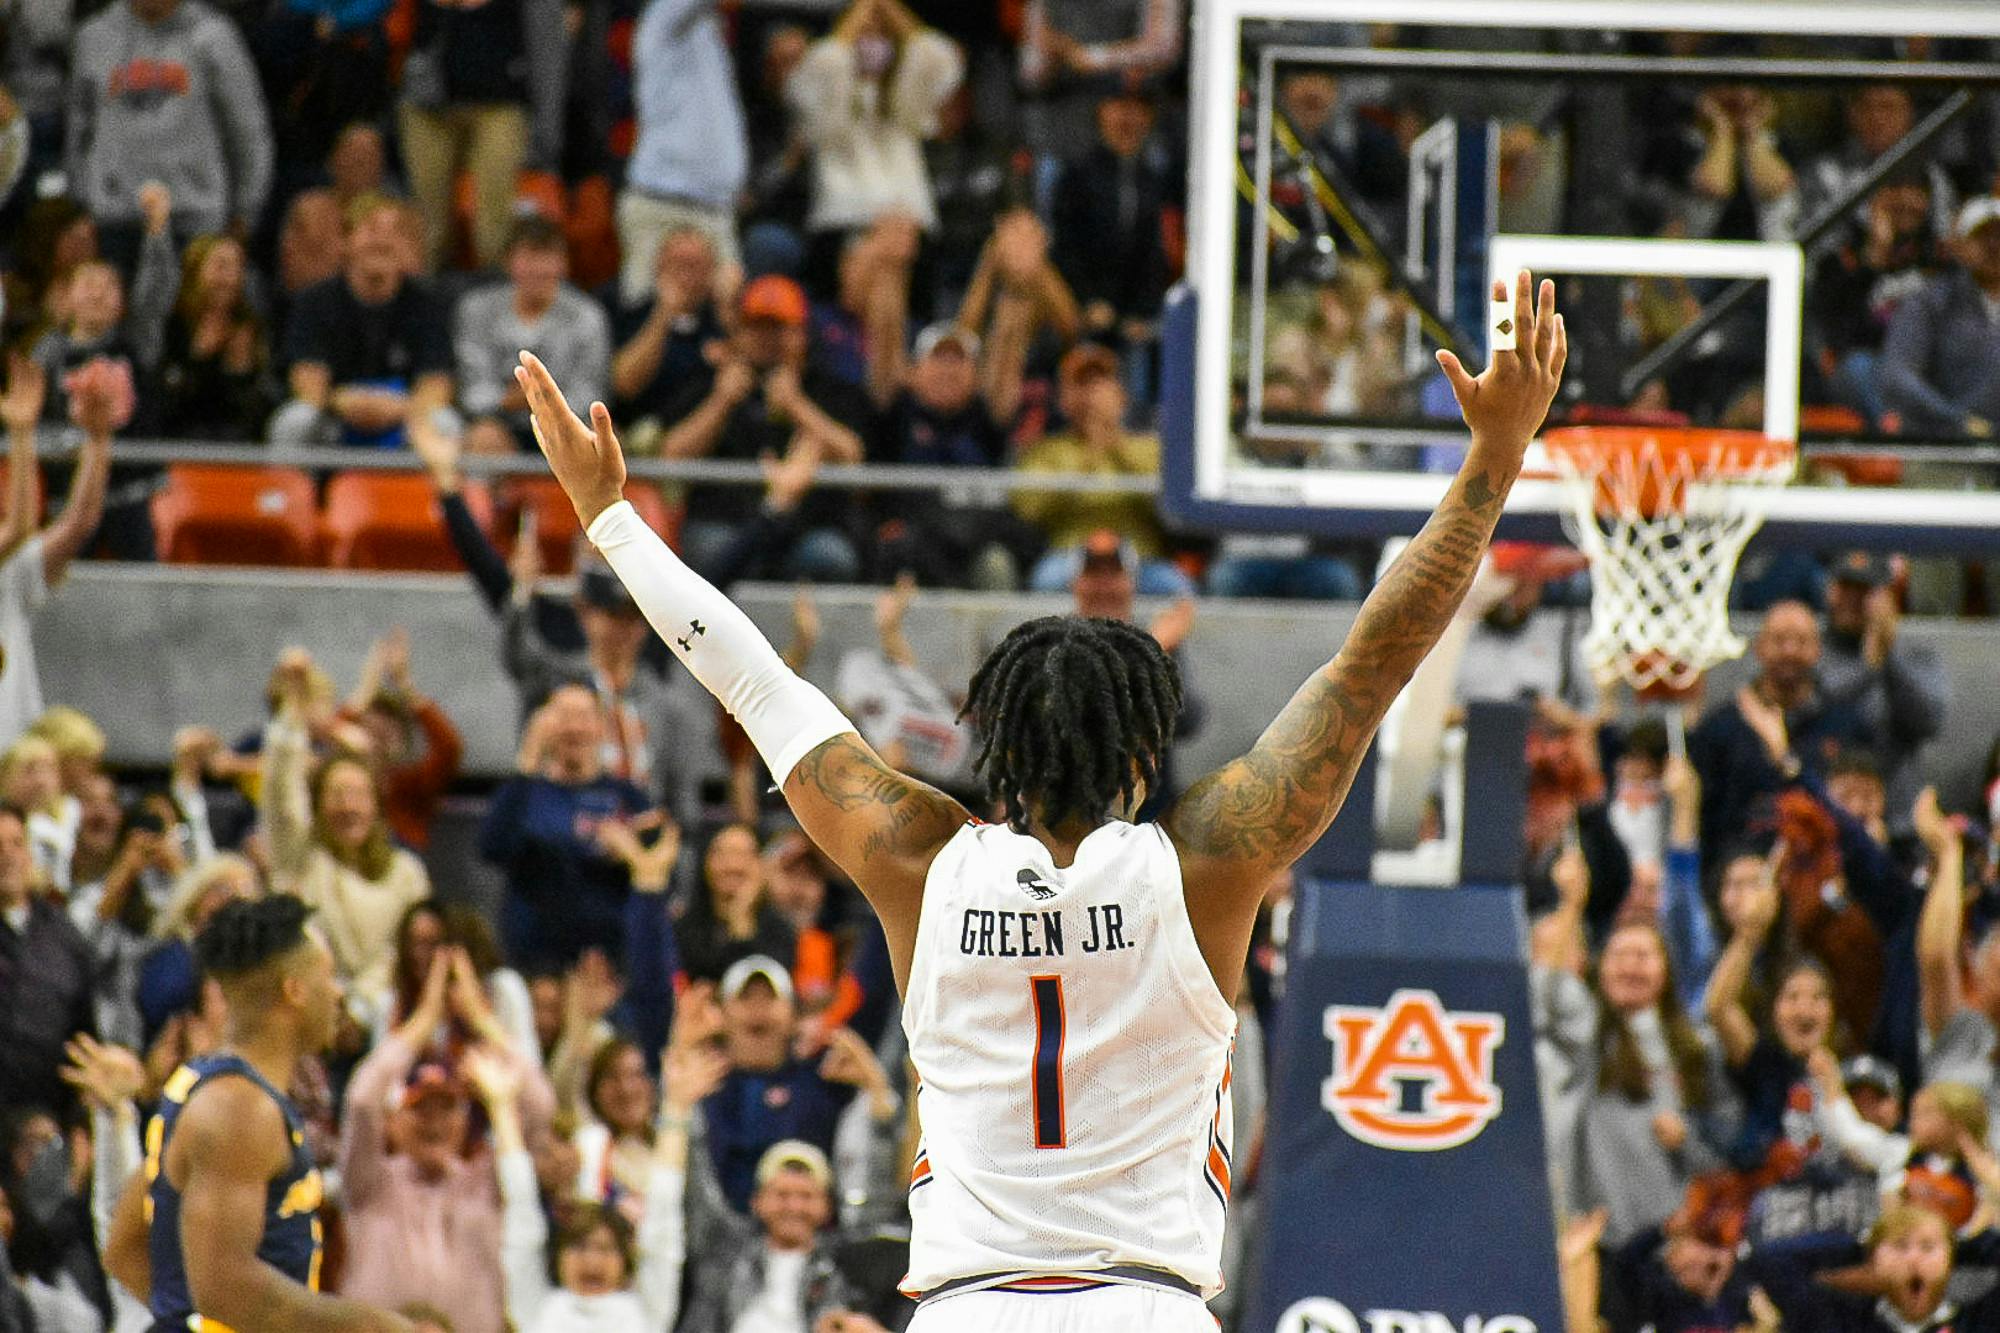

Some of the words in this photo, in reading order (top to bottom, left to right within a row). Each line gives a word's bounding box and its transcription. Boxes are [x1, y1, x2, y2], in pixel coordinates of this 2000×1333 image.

[960, 908, 1064, 957] GREEN
[1082, 904, 1135, 953] JR.
[1030, 974, 1066, 1149] 1
